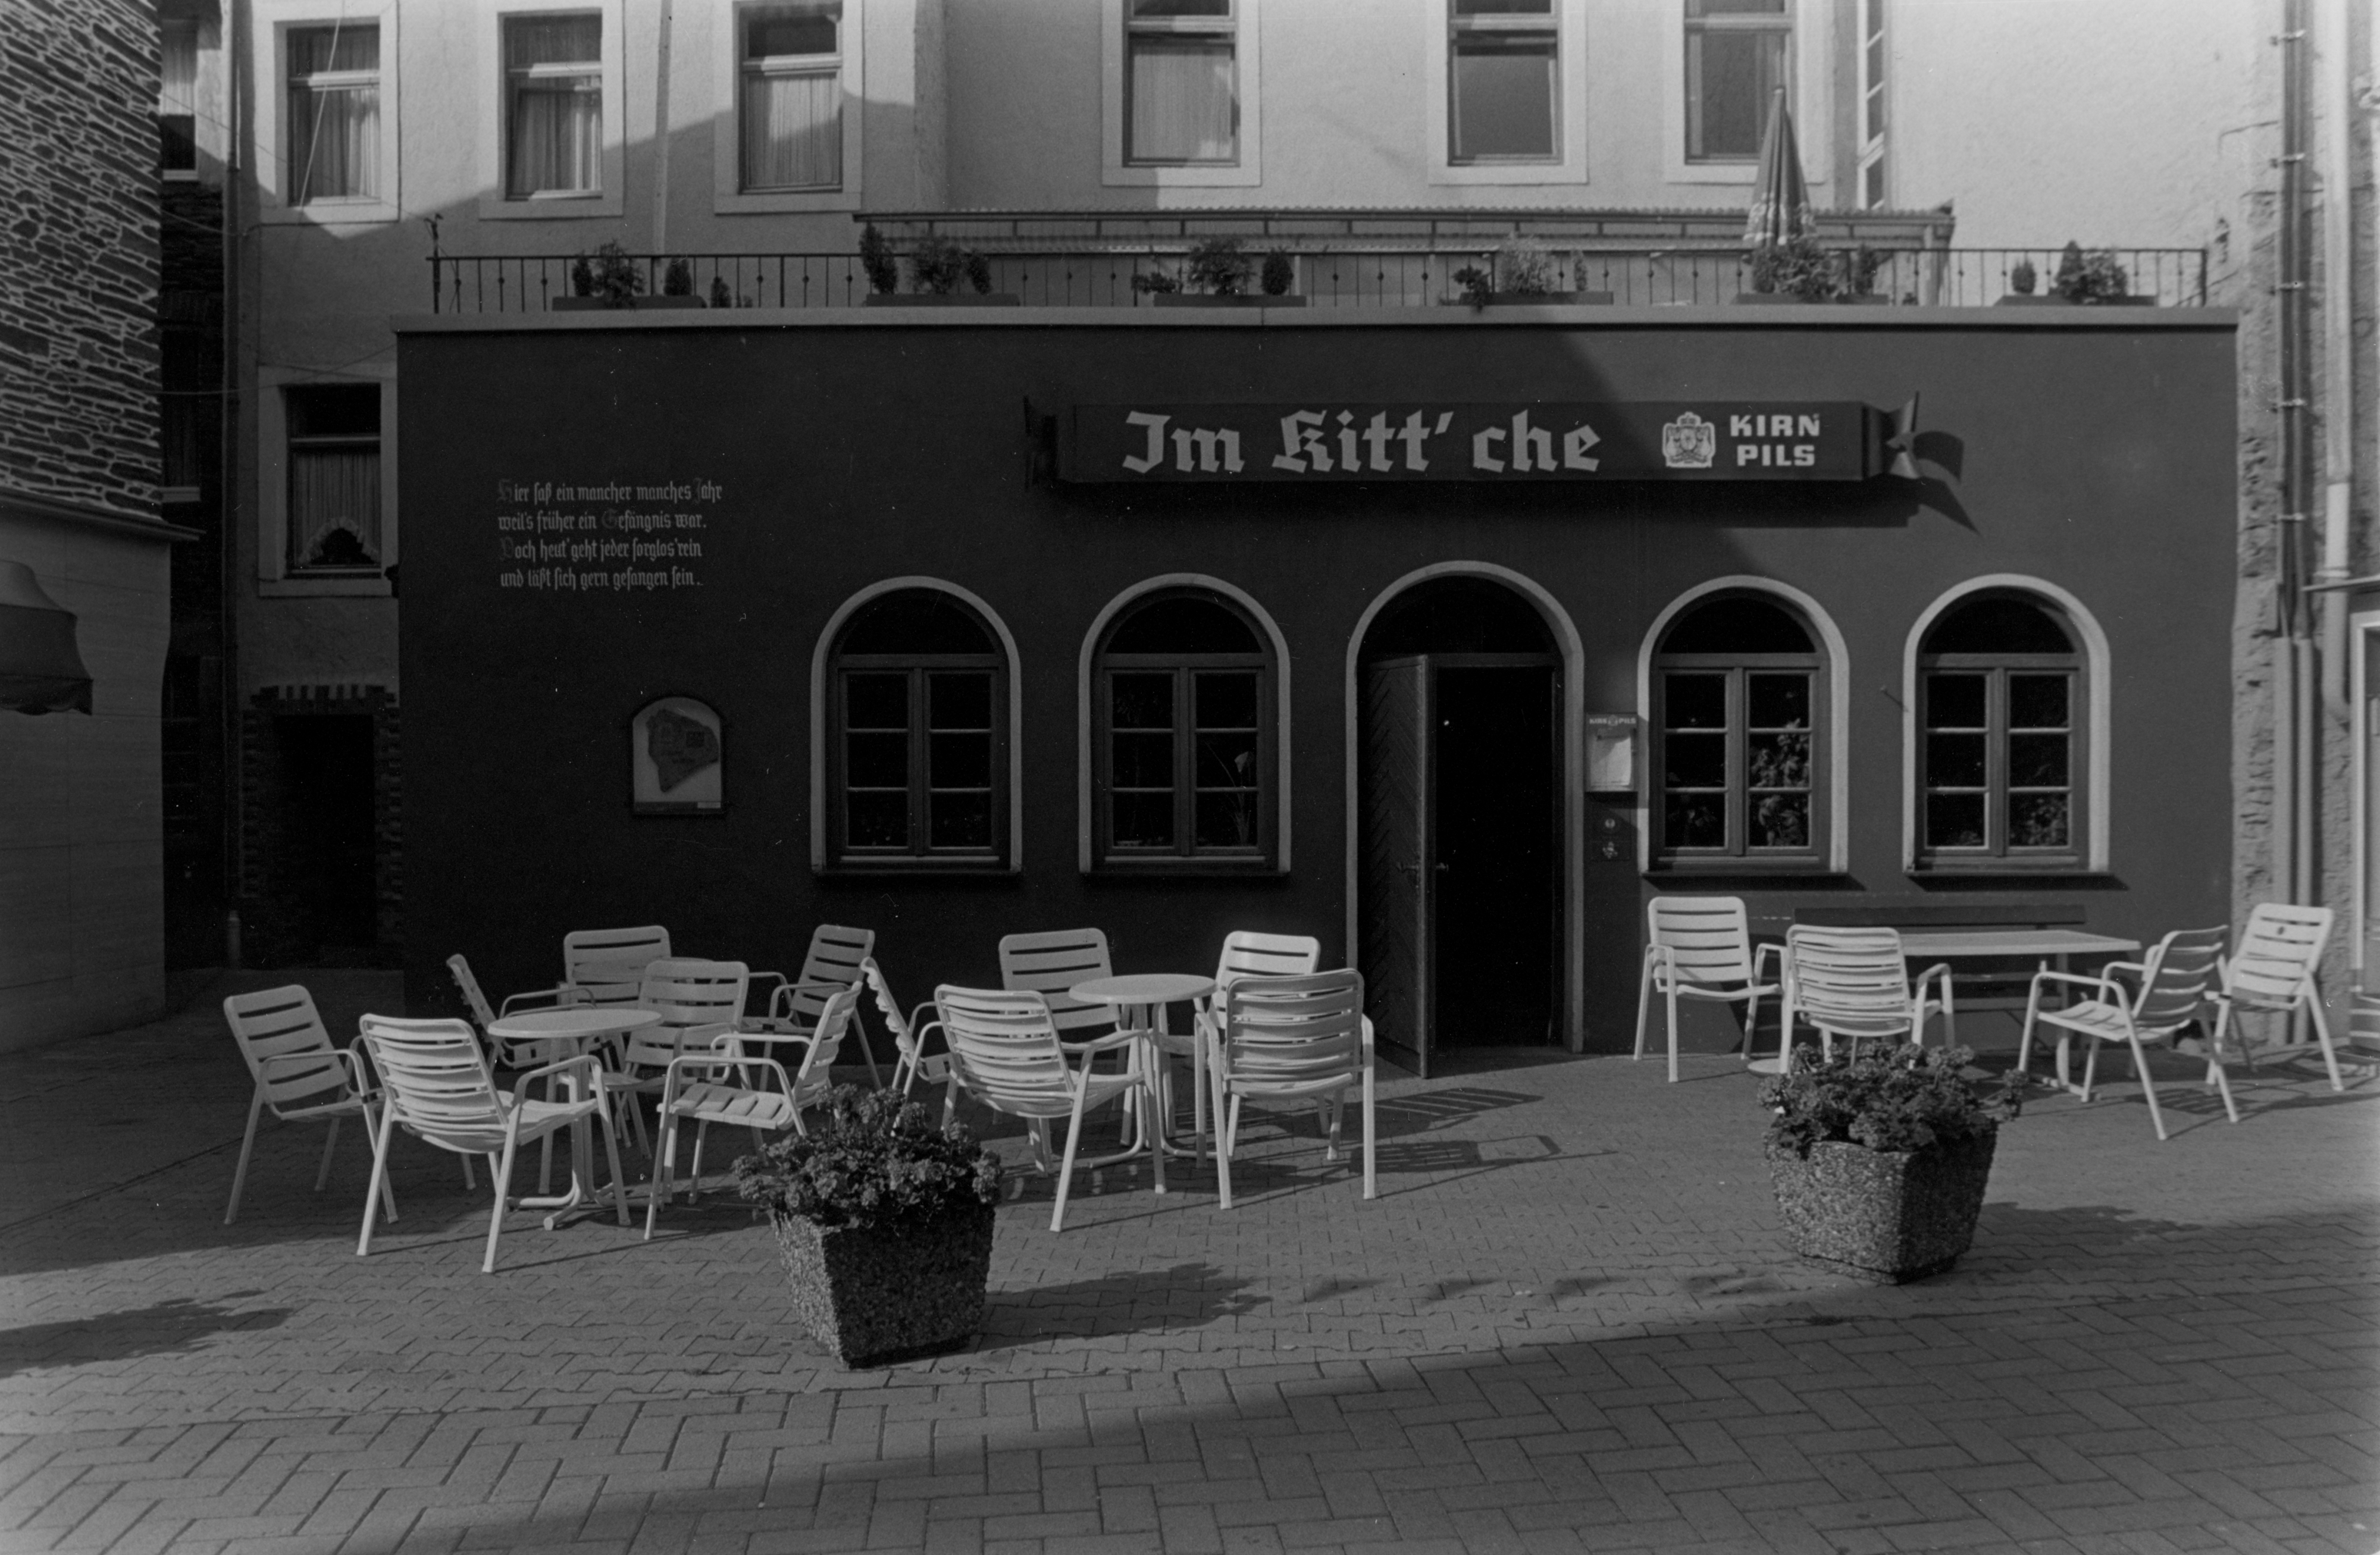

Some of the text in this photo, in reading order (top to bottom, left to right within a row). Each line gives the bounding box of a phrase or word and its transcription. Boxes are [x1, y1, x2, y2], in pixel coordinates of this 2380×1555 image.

[1730, 413, 1820, 437] KIRN
[1122, 410, 1245, 474] Im
[1737, 444, 1815, 466] PILS
[496, 478, 529, 504] Hier
[556, 482, 575, 501] ein
[577, 481, 632, 504] mancher
[636, 481, 691, 504] manches
[693, 477, 723, 504] Jahr
[497, 508, 707, 534] weil's früher ein Gefängnis war.
[500, 537, 536, 563] Doch
[571, 538, 597, 563] geht
[600, 538, 630, 563] jeder
[500, 566, 700, 591] und läßt sich gern gefangen sein.
